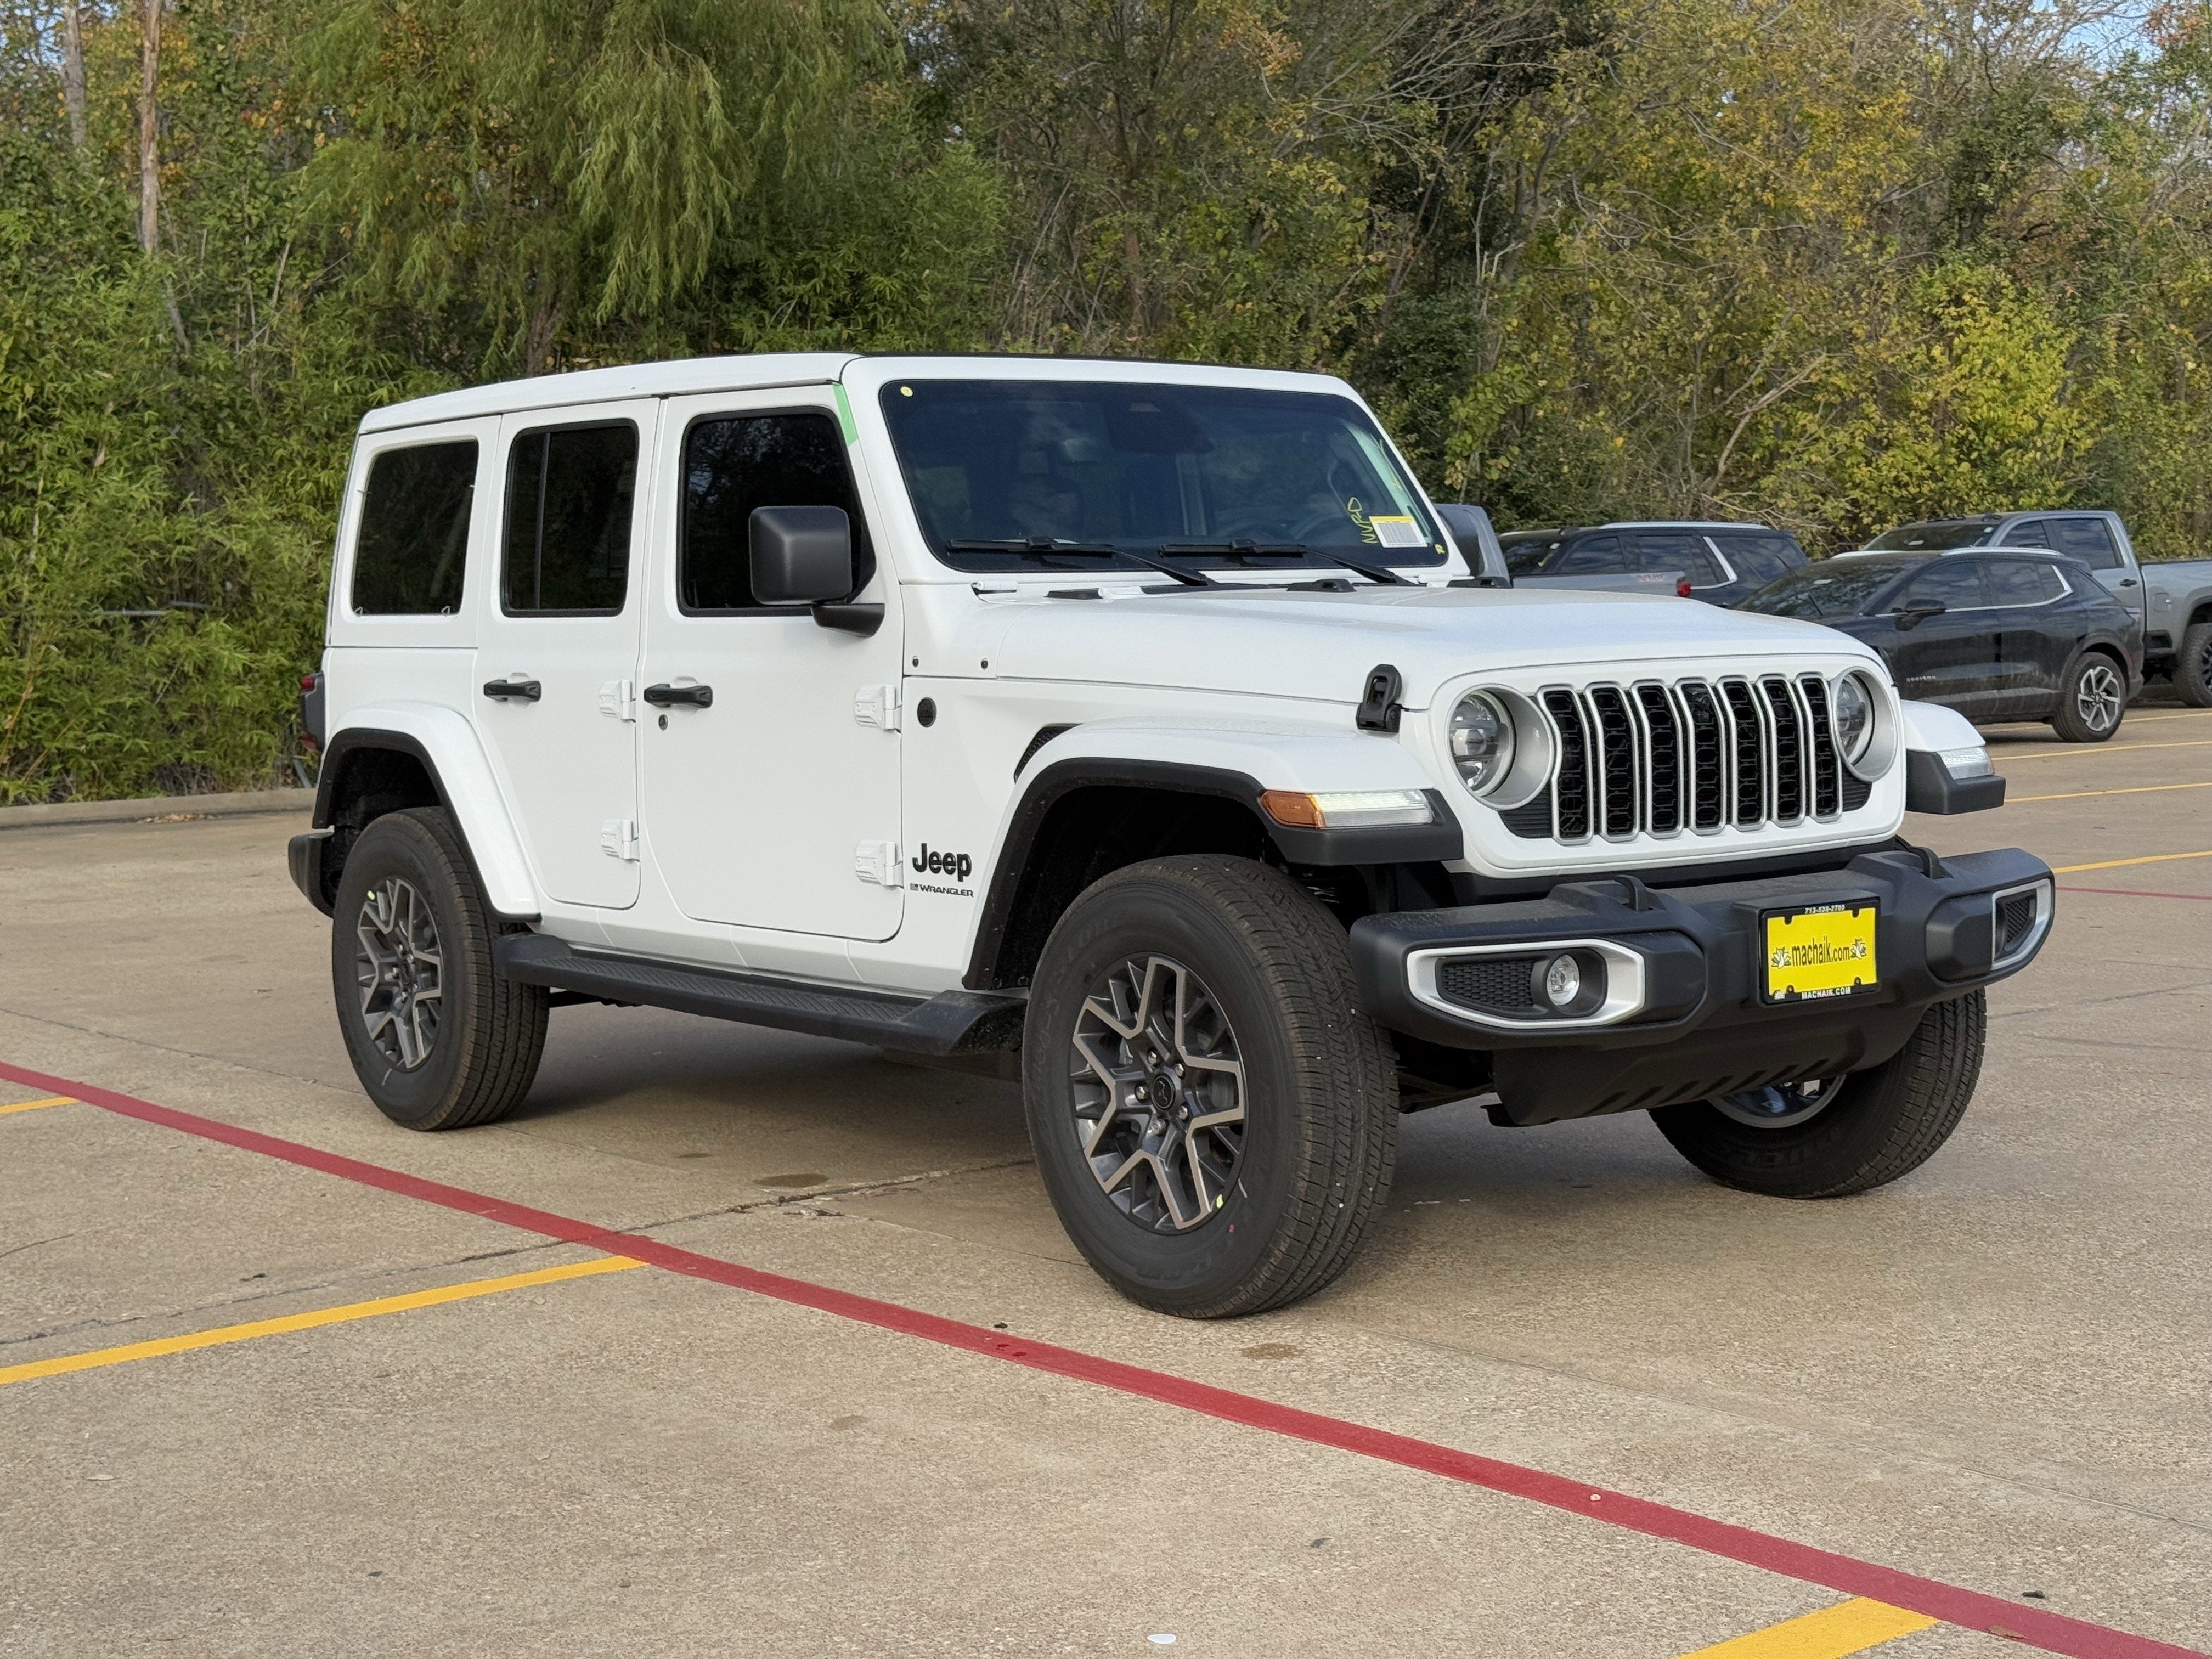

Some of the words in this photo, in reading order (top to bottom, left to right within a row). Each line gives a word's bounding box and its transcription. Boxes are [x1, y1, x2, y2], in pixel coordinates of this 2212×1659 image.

[912, 843, 972, 882] Jeep
[919, 884, 974, 898] WRANGLER
[1791, 935, 1850, 967] machaik.com
[1801, 986, 1852, 1000] MACHAIK.COM
